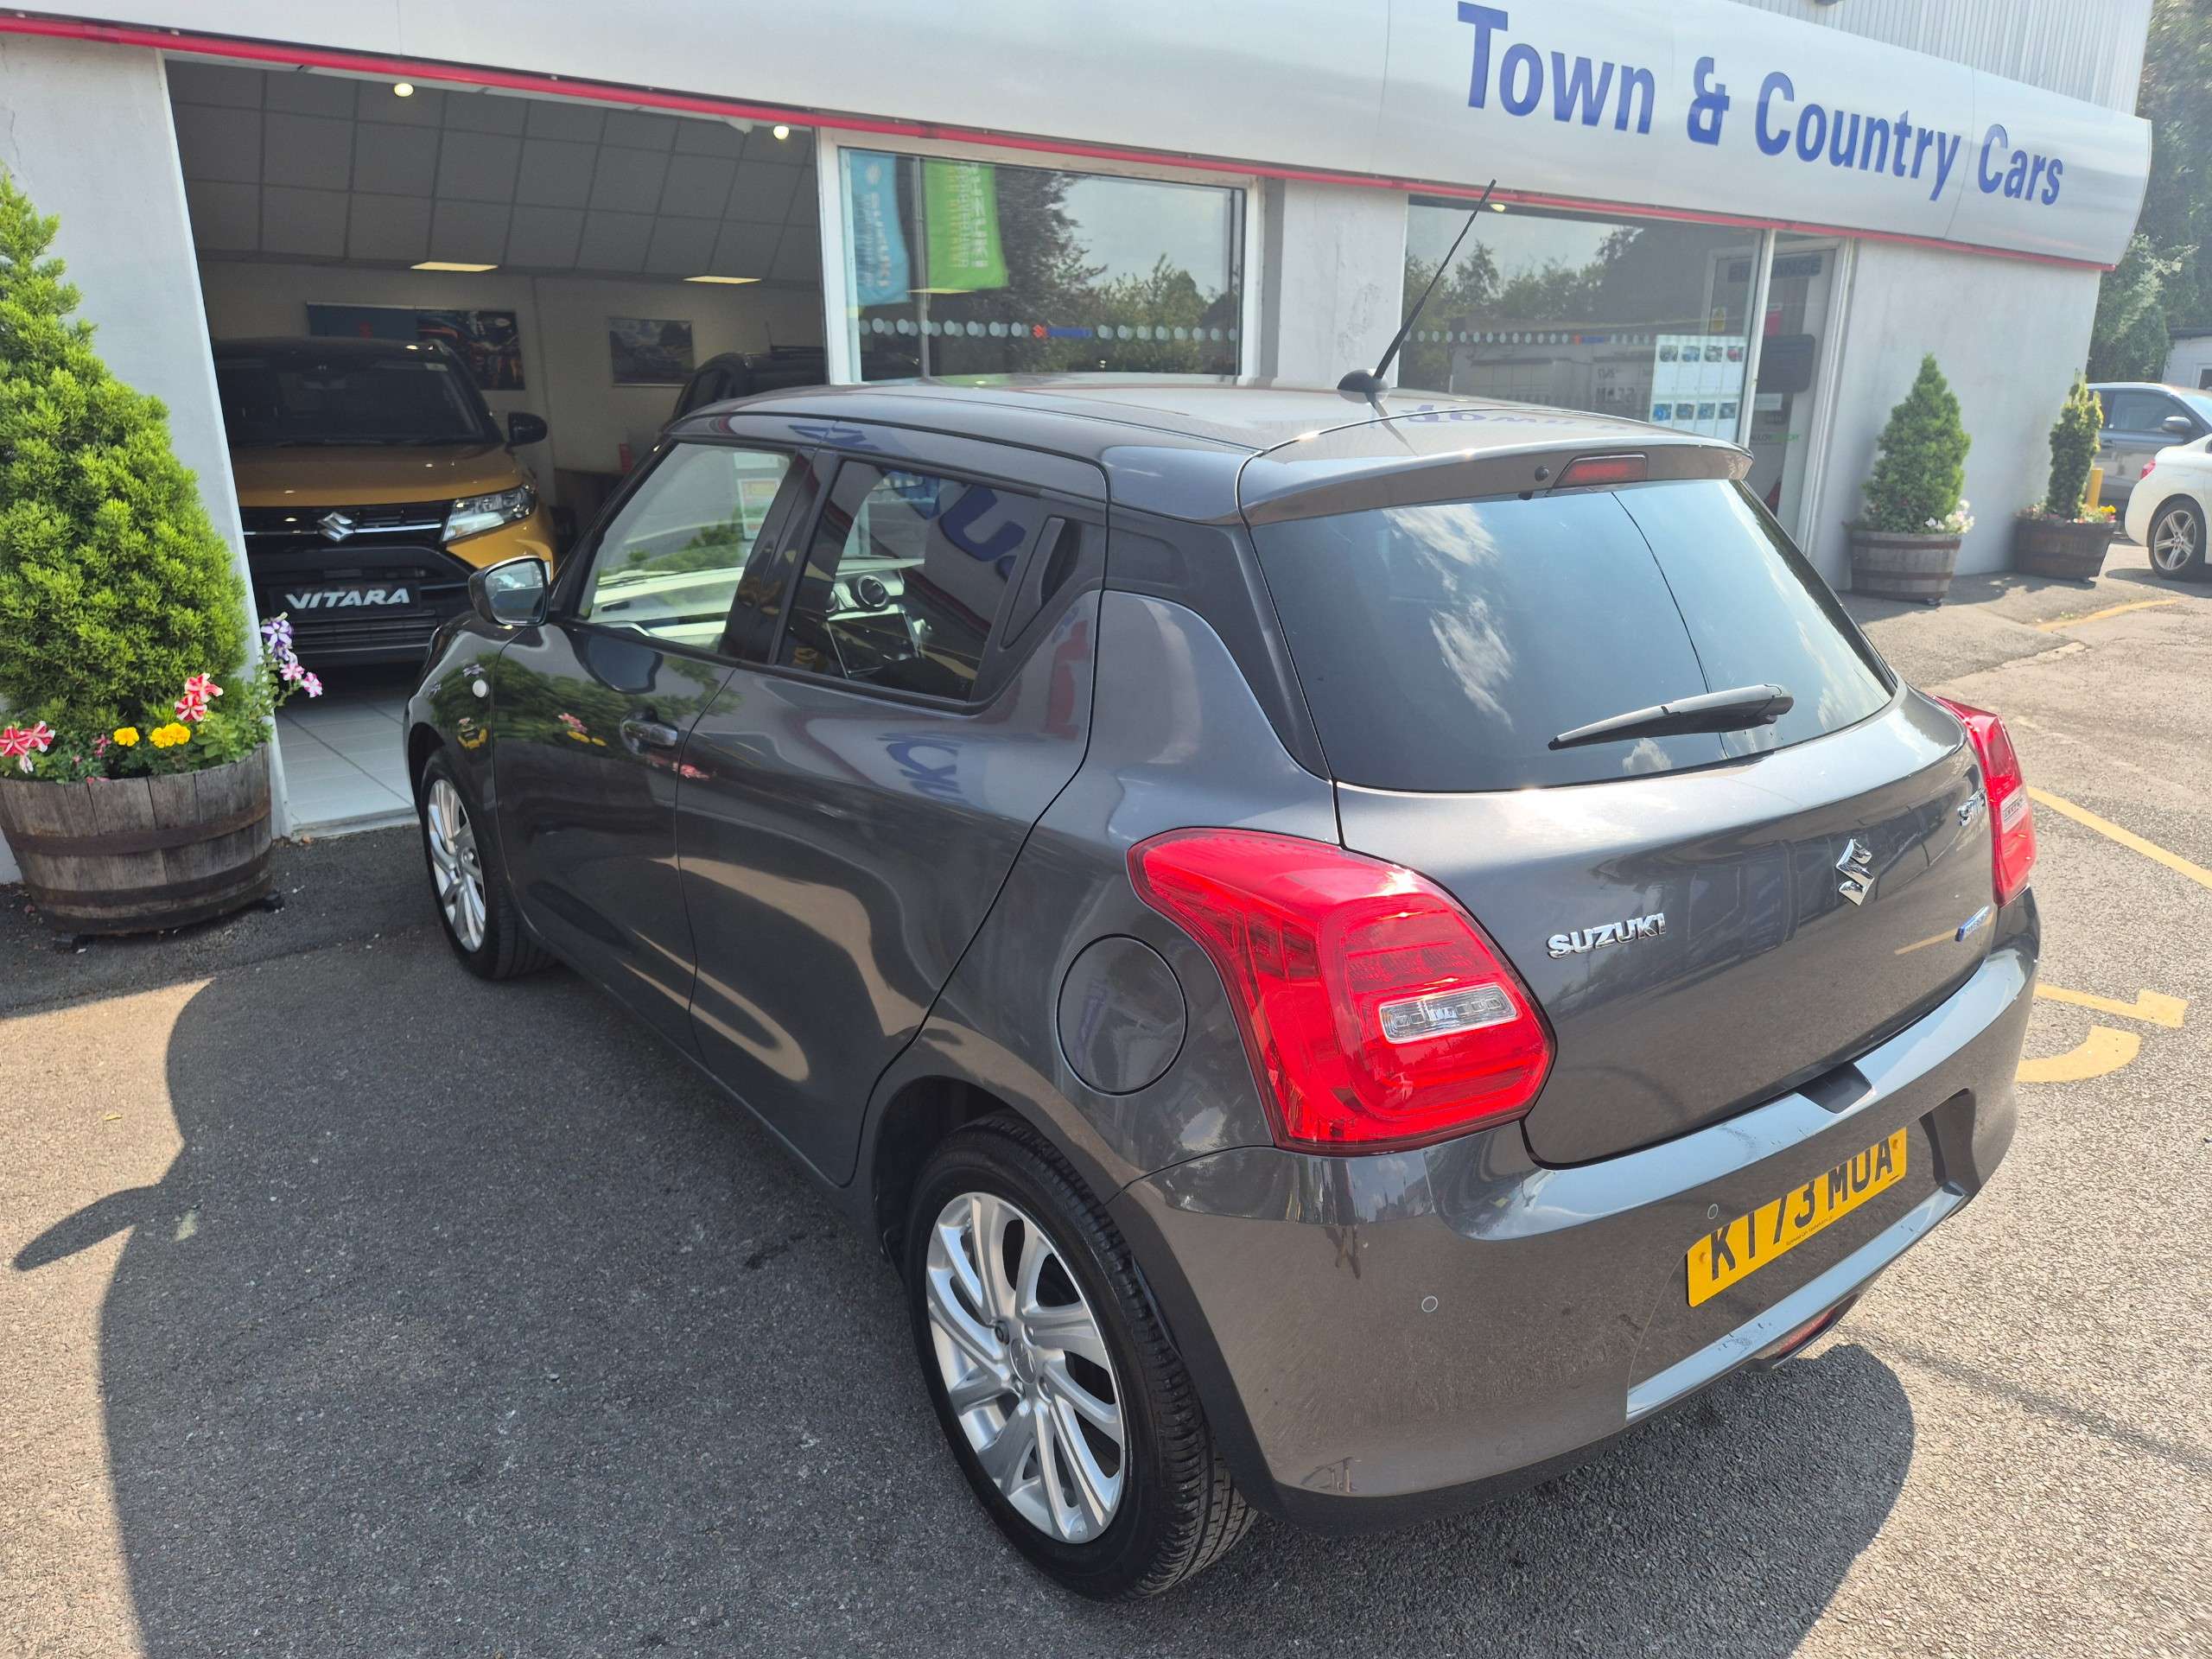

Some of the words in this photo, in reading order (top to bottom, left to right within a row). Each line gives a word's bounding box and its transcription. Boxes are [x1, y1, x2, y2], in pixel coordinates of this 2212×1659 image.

[1457, 2, 1655, 135] Town
[1687, 56, 1730, 146] &
[1755, 73, 1961, 201] Country
[1978, 124, 2064, 207] Cars
[285, 588, 410, 609] VITARA
[1546, 912, 1666, 959] SUZUKI
[1828, 1138, 1893, 1211] MUA
